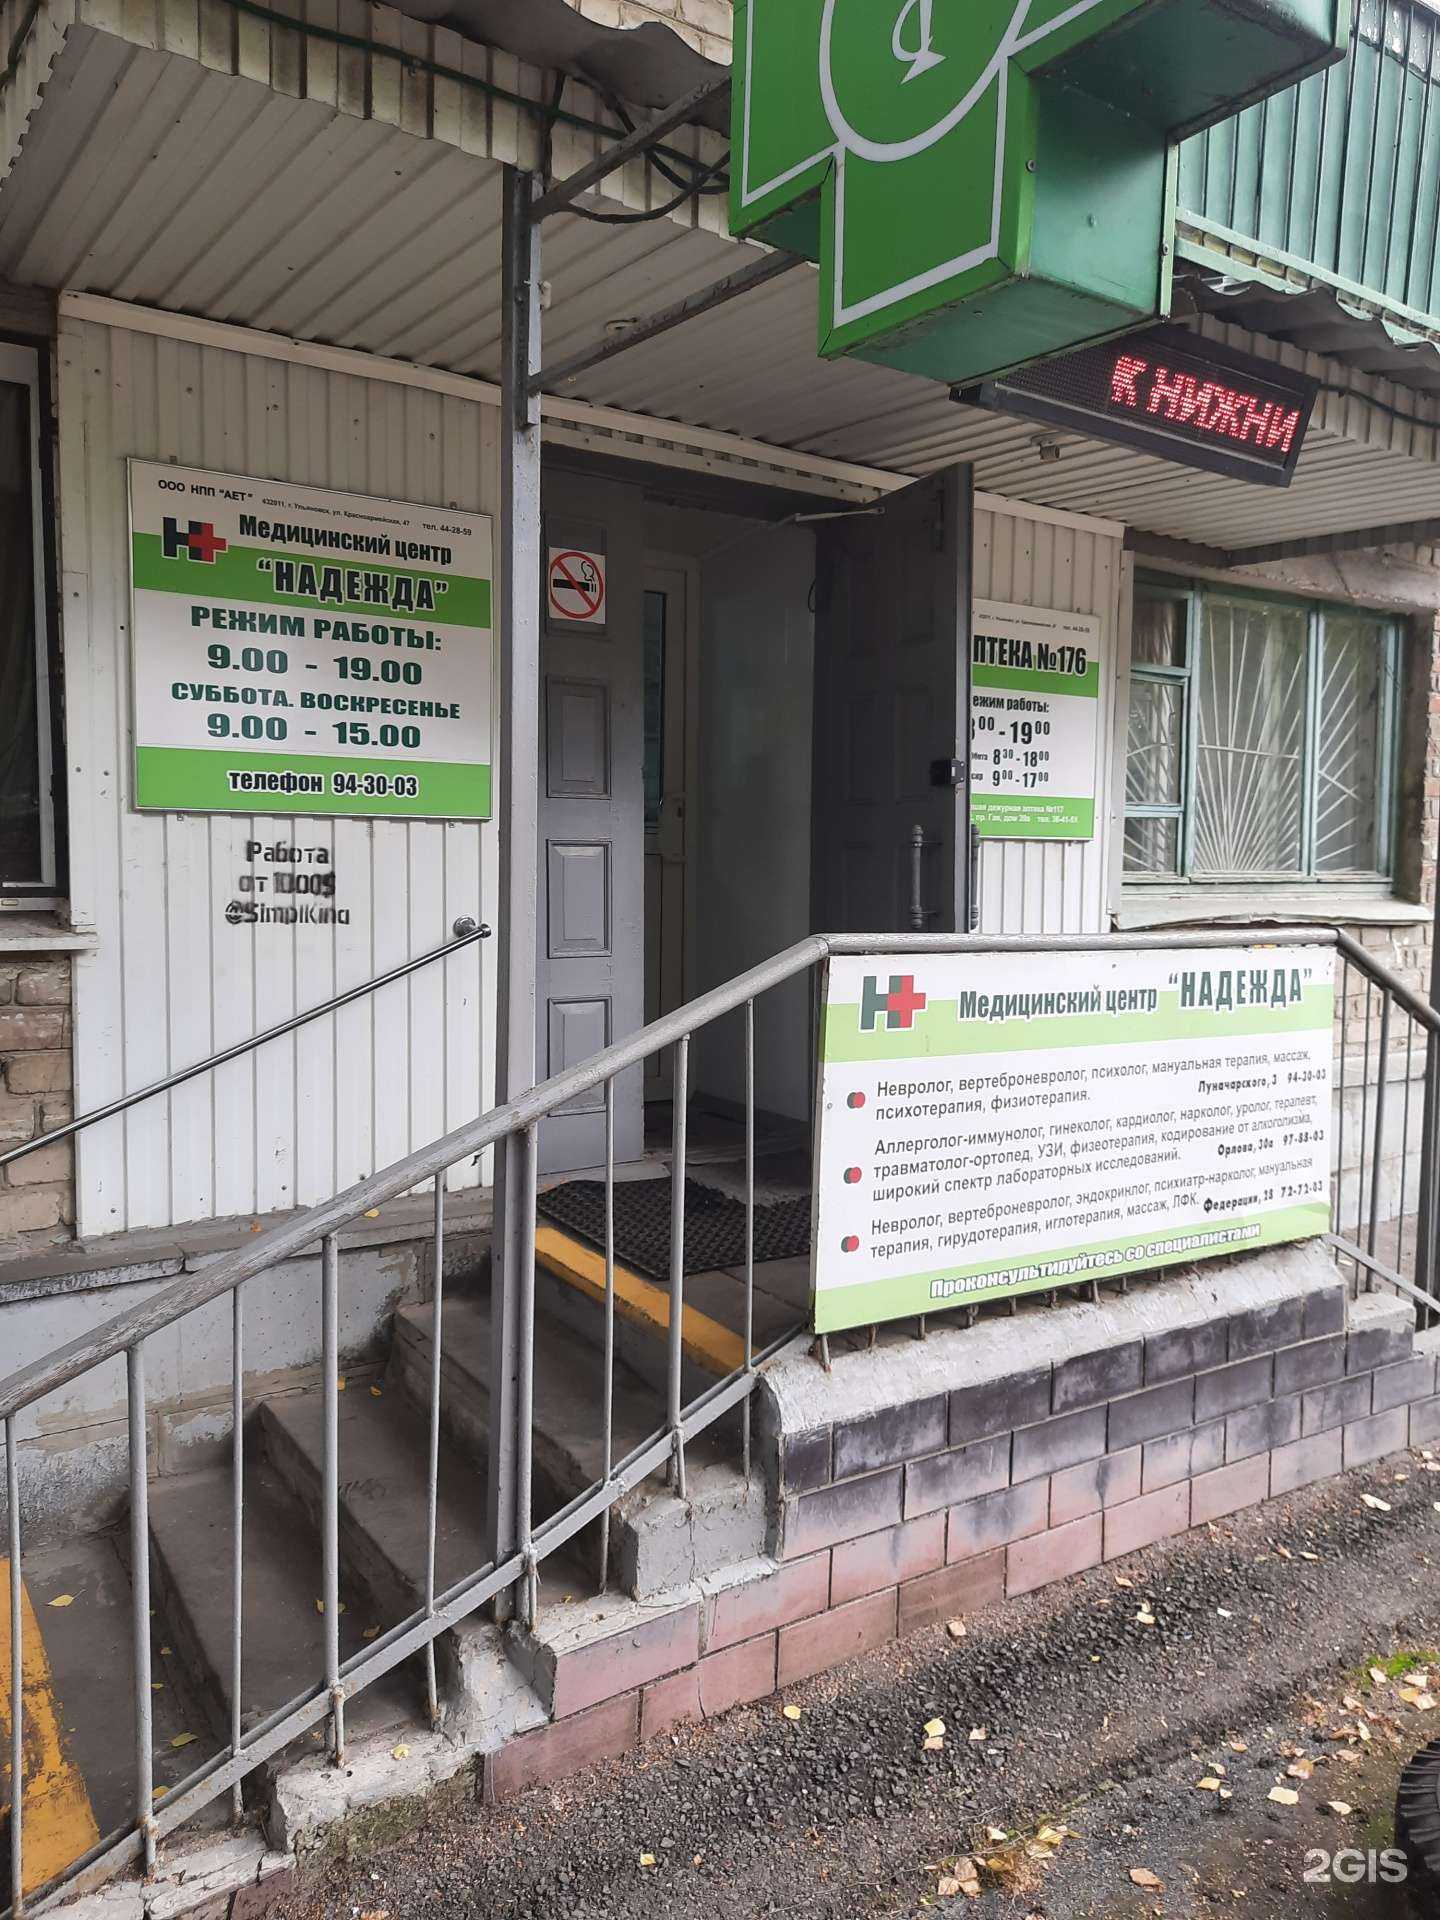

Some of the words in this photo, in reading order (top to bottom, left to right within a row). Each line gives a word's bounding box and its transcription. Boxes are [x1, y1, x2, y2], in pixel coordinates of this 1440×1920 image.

[1111, 355, 1148, 407] К
[1146, 366, 1300, 453] НИЖНИ
[158, 479, 186, 492] ООО
[190, 484, 216, 497] НПП
[239, 514, 391, 556] Медицинский
[395, 543, 453, 566] центр
[422, 522, 438, 531] тел.
[258, 559, 449, 611] “НАДЕЖДА”
[190, 605, 305, 637] РЕЖИМ
[313, 619, 442, 651] РАБОТЫ:
[207, 643, 288, 674] 9.00
[333, 656, 423, 685] 19.00
[973, 635, 1033, 669] ПТЕКА
[1037, 643, 1087, 675] №176
[171, 682, 295, 708] СУББОТА.
[300, 691, 461, 719] ВОСКРЕСЕНЬЕ
[972, 695, 1005, 709] ежим
[1006, 698, 1050, 713] работы:
[207, 713, 288, 741] 9.00
[332, 721, 422, 748] 15.00
[228, 771, 323, 794] телефон
[332, 773, 418, 796] 94-30-03
[246, 840, 329, 864] Работа
[239, 875, 269, 893] от
[959, 984, 1101, 1020] Медицинский
[1105, 989, 1158, 1014] центр
[1168, 968, 1313, 1010] “НАДЕЖДА”
[877, 1080, 954, 1098] Невролог,
[958, 1069, 1088, 1092] вертеброневролог,
[1092, 1065, 1149, 1080] психолог,
[1151, 1057, 1222, 1076] мануальная
[1225, 1053, 1270, 1068] терапия,
[1198, 1076, 1270, 1095] Луначарского,
[876, 1099, 986, 1121] психотерапия,
[991, 1088, 1091, 1113] физиотерапия.
[874, 1124, 1045, 1156] Аллерголог-иммунолог,
[1049, 1117, 1112, 1137] гинеколог,
[1115, 1109, 1177, 1129] кардиолог,
[1180, 1104, 1233, 1123] нарколог,
[1236, 1100, 1272, 1117] уролог,
[873, 1149, 1033, 1181] травматолог-ортопед,
[1037, 1142, 1066, 1159] УЗИ,
[1070, 1133, 1158, 1157] физеотерапия,
[1160, 1125, 1235, 1144] кодирование
[1237, 1121, 1250, 1134] от
[871, 1213, 943, 1236] Невролог,
[948, 1193, 1072, 1226] вертеброневролог,
[1076, 1182, 1152, 1205] эндокринлог,
[1154, 1168, 1257, 1192] психиатр-нарколог,
[1258, 1156, 1314, 1176] мануальная
[873, 1178, 940, 1203] широкий
[944, 1174, 992, 1193] спектр
[996, 1160, 1092, 1185] лабораторных
[1095, 1147, 1182, 1172] исследований.
[871, 1237, 933, 1260] терапия,
[937, 1221, 1041, 1250] гирудотерапия,
[1045, 1207, 1124, 1231] иглотерапия,
[1126, 1199, 1170, 1217] массаж,
[1172, 1192, 1200, 1209] ЛФК.
[930, 1249, 1123, 1298] Проконсультируйтесь
[1125, 1245, 1144, 1261] со
[1146, 1223, 1262, 1258] специалистами
